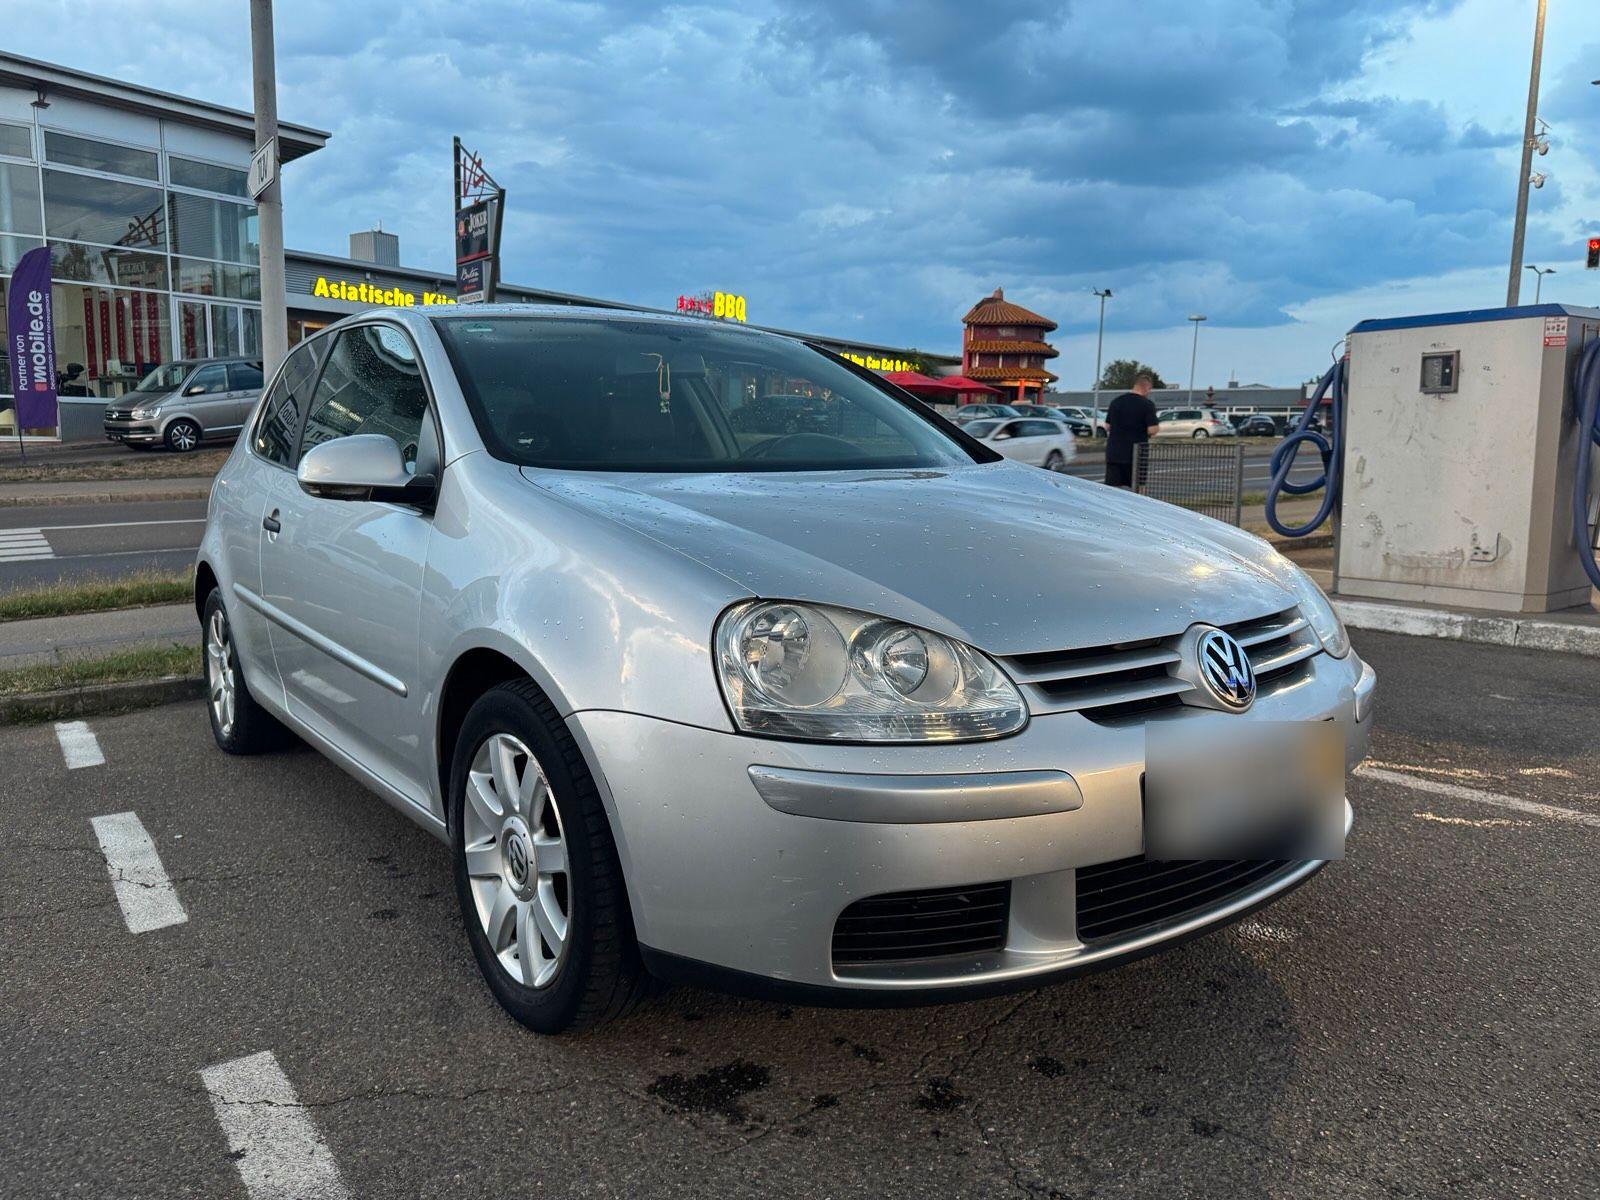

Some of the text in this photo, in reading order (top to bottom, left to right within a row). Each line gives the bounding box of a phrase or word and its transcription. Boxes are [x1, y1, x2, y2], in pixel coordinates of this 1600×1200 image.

[468, 210, 488, 233] JOKER
[314, 277, 415, 307] Asiatische
[714, 291, 746, 322] BBQ
[27, 290, 47, 383] mobile.de
[16, 334, 28, 391] Partner von
[867, 356, 881, 369] Can
[881, 358, 894, 371] Eat
[895, 360, 902, 372] &
